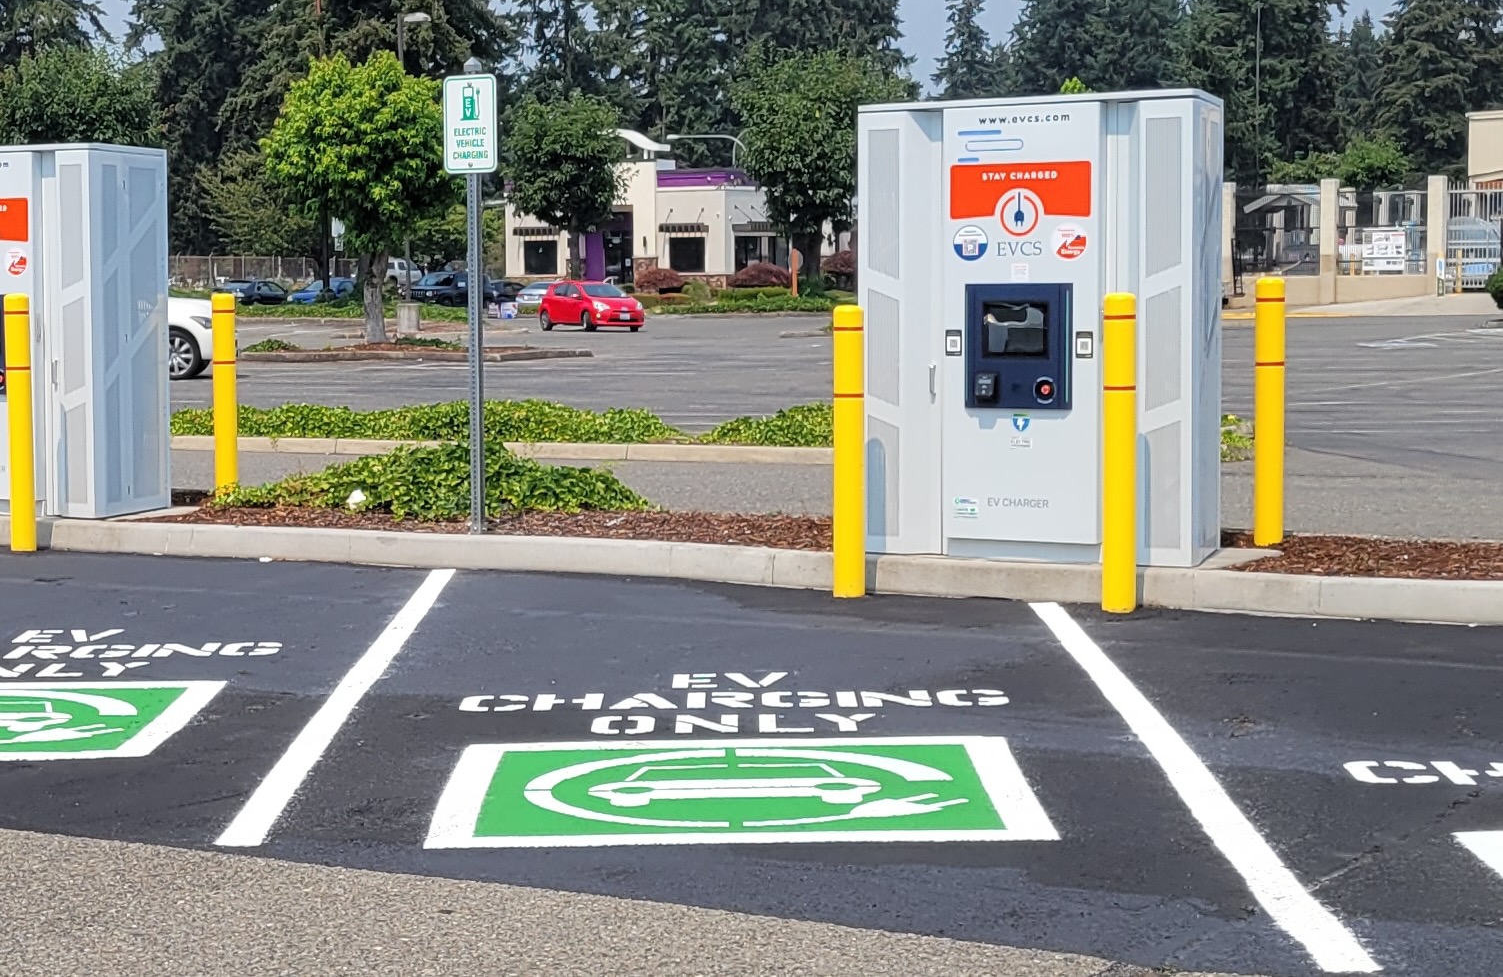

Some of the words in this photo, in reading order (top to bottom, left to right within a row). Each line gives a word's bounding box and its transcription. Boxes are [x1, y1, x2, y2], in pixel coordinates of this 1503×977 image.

[978, 113, 1071, 125] www.evcs.com
[453, 127, 487, 137] ELECTRIC
[456, 139, 485, 148] VEHICLE
[452, 150, 489, 160] CHARGING
[981, 171, 1007, 182] STAY
[1009, 170, 1058, 180] CHARGED
[996, 241, 1043, 257] EVCS
[987, 497, 1000, 507] EV
[1002, 497, 1050, 509] CHARGER
[11, 628, 126, 644] EV
[671, 671, 789, 689] EV
[458, 688, 1011, 713] CHARGING
[590, 712, 878, 735] ONLY
